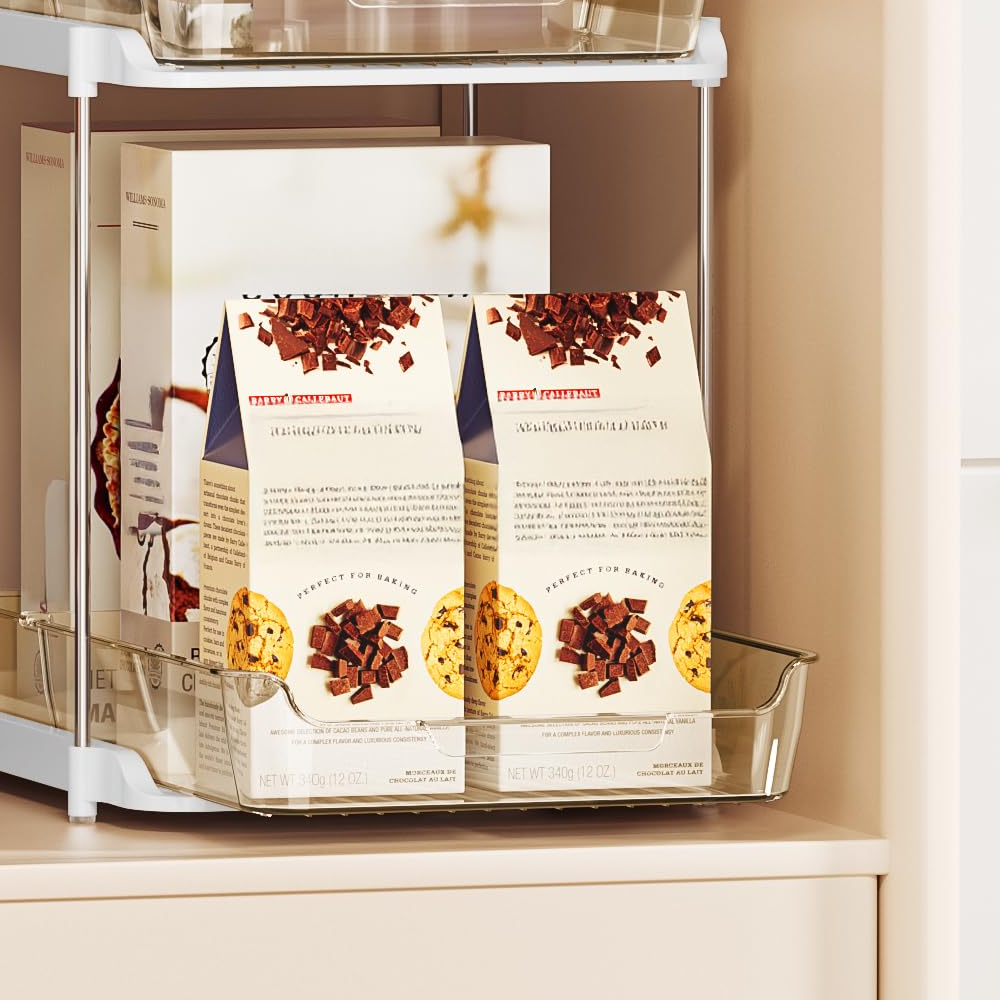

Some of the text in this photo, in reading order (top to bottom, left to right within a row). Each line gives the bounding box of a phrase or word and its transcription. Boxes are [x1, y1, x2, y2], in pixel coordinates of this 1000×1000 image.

[297, 574, 344, 599] PERFECT
[545, 567, 593, 593] PERFECT
[259, 774, 277, 787] NET
[507, 767, 526, 780] NET
[529, 766, 545, 779] WT
[547, 766, 574, 781] 340g
